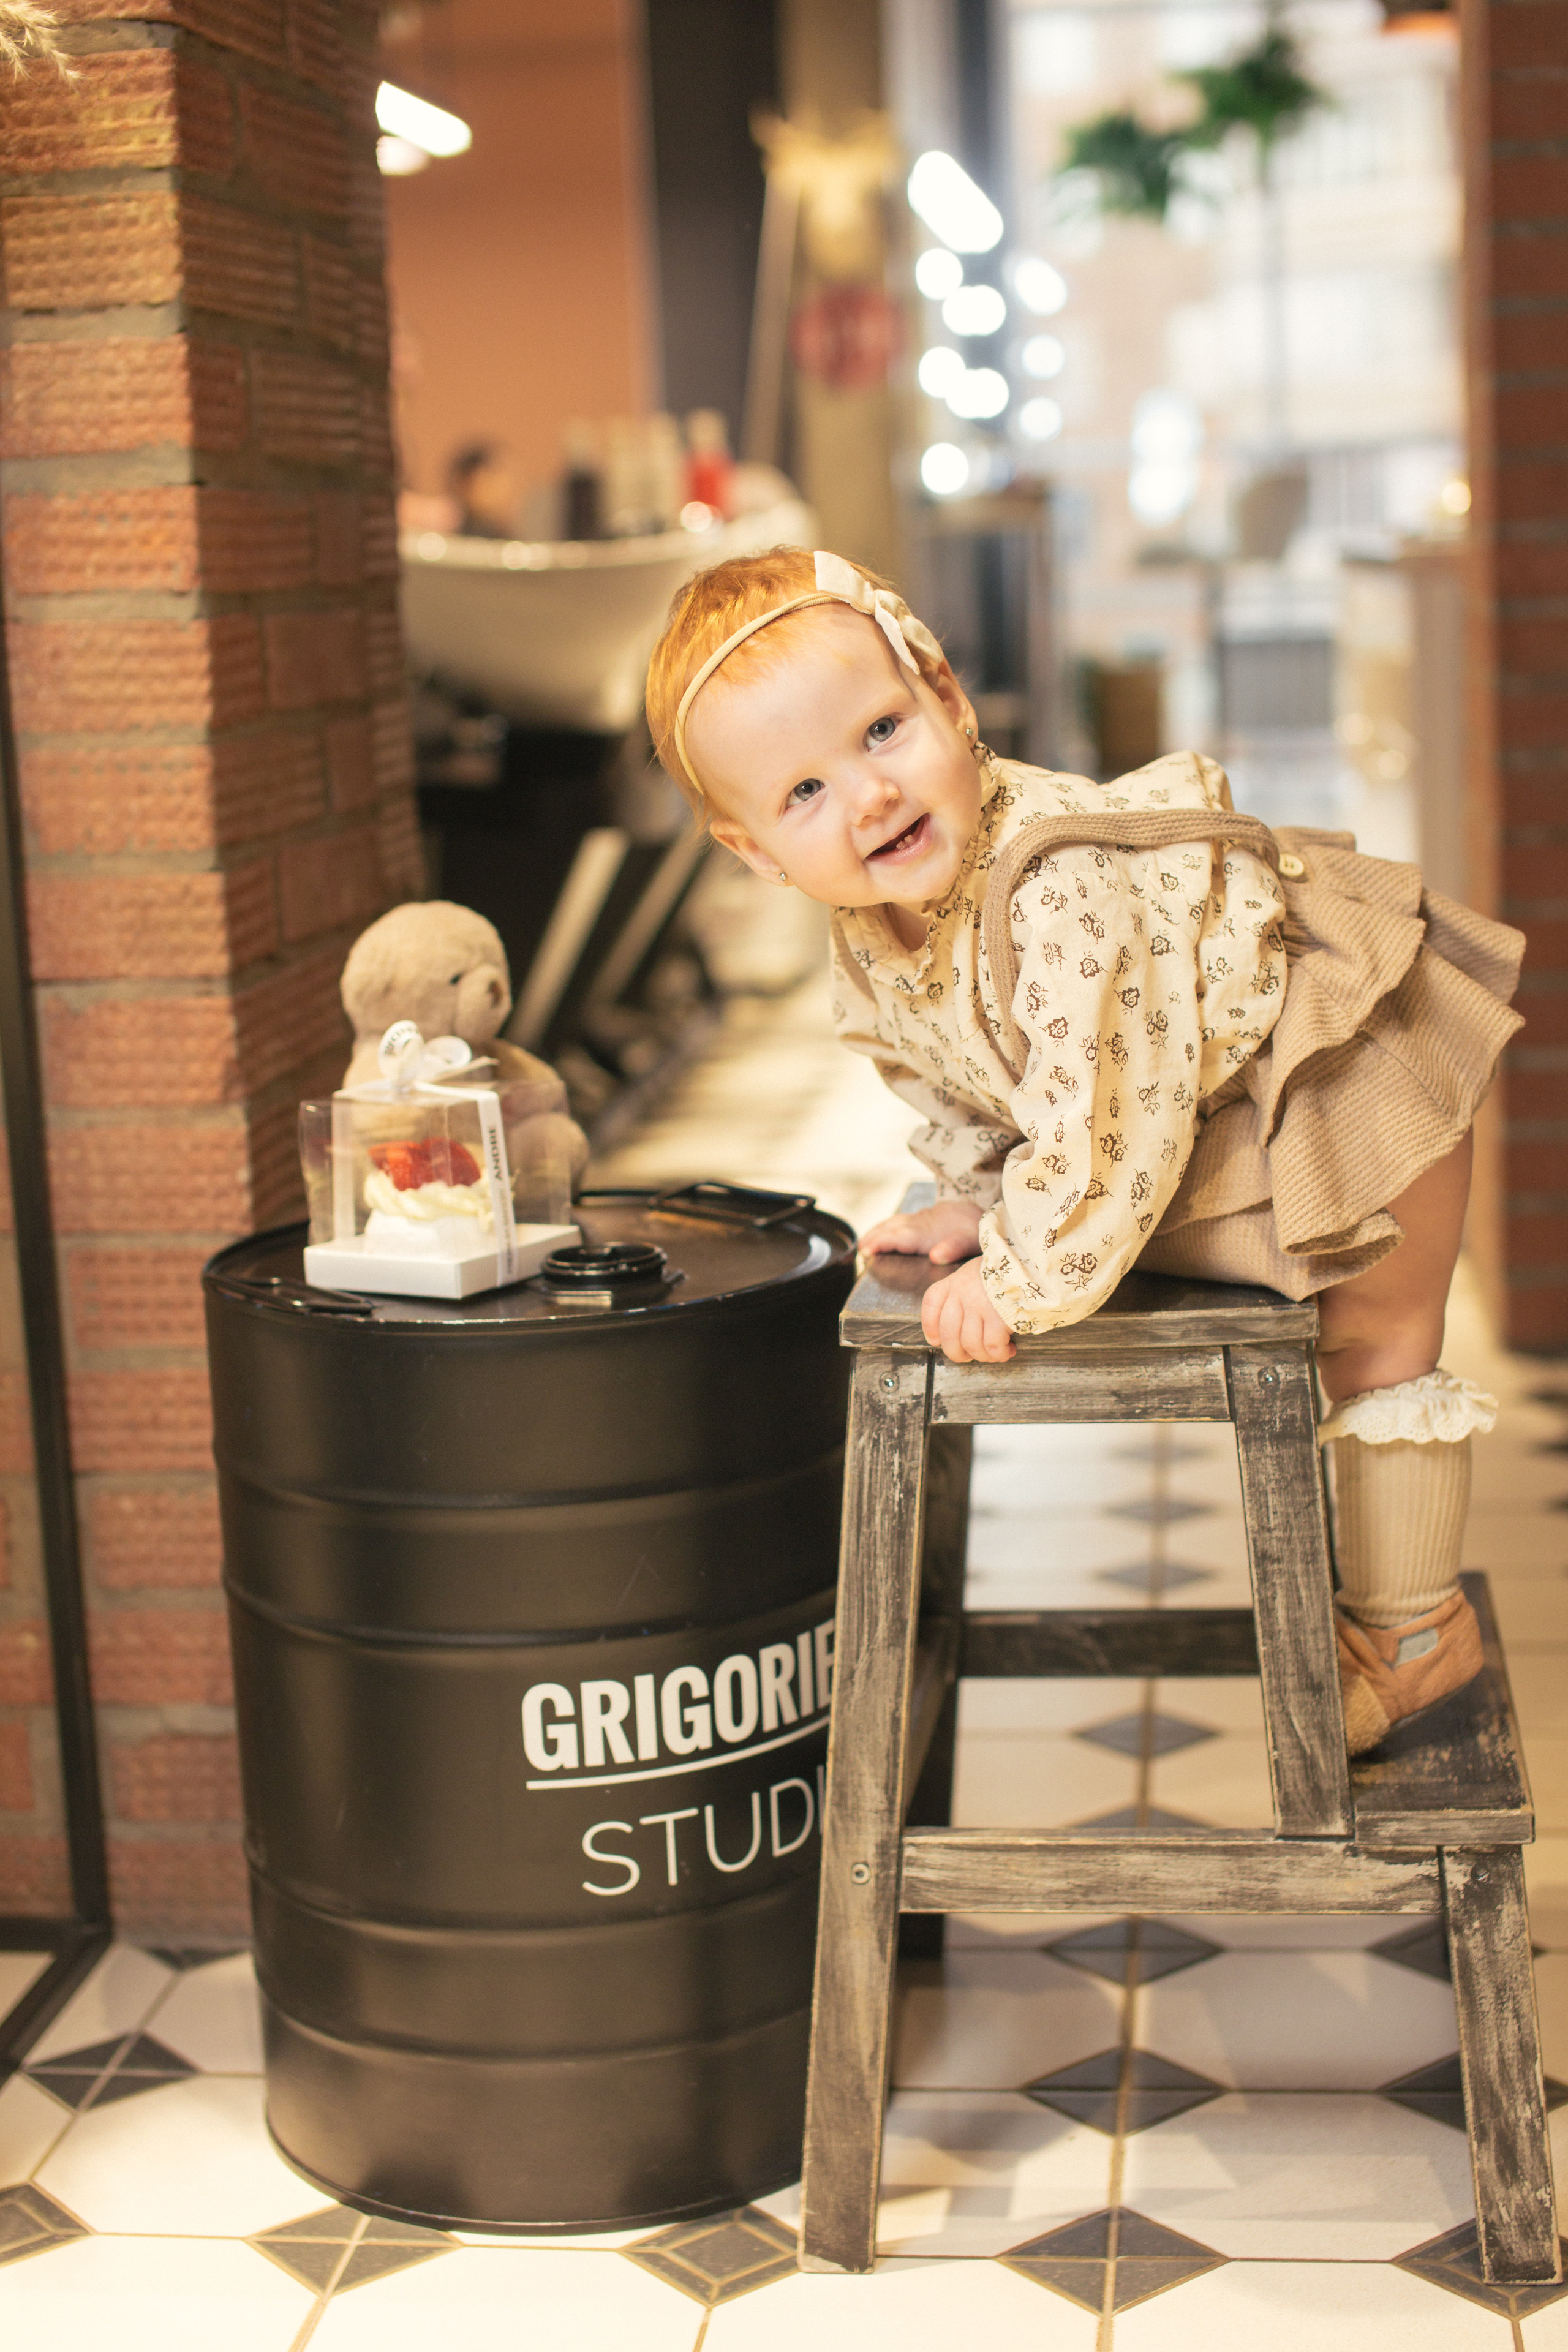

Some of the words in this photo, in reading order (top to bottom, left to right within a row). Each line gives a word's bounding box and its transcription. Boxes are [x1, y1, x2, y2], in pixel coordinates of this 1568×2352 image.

[488, 1126, 502, 1181] ANDRE
[521, 1618, 835, 1771] GRIGORIE
[581, 1765, 825, 1896] STUDI
